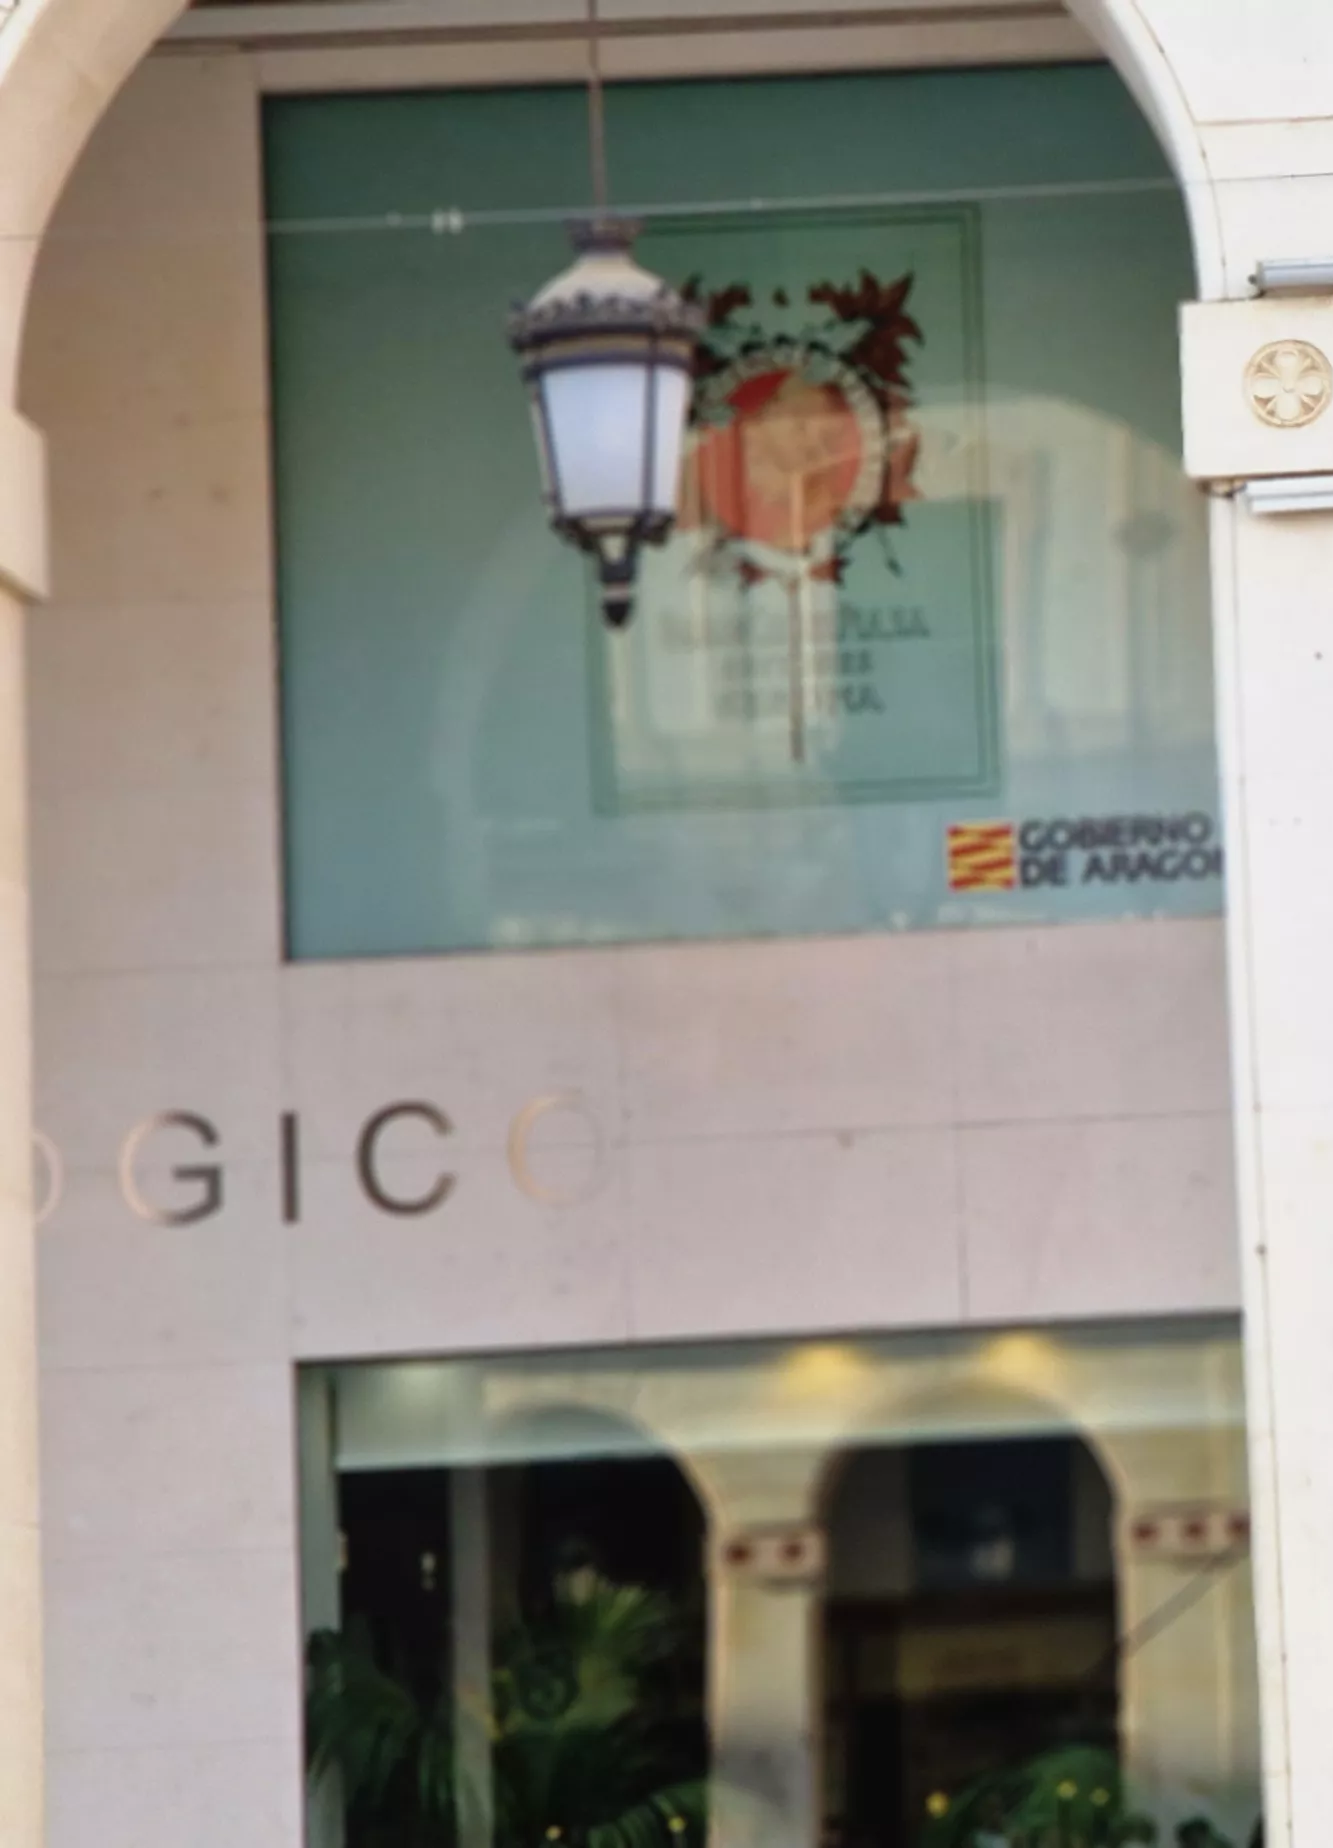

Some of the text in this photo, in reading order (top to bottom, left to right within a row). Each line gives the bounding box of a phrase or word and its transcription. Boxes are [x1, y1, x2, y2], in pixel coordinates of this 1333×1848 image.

[1019, 811, 1214, 852] GOBIERNO
[1021, 853, 1067, 889] DE
[33, 1092, 605, 1228] GICO
